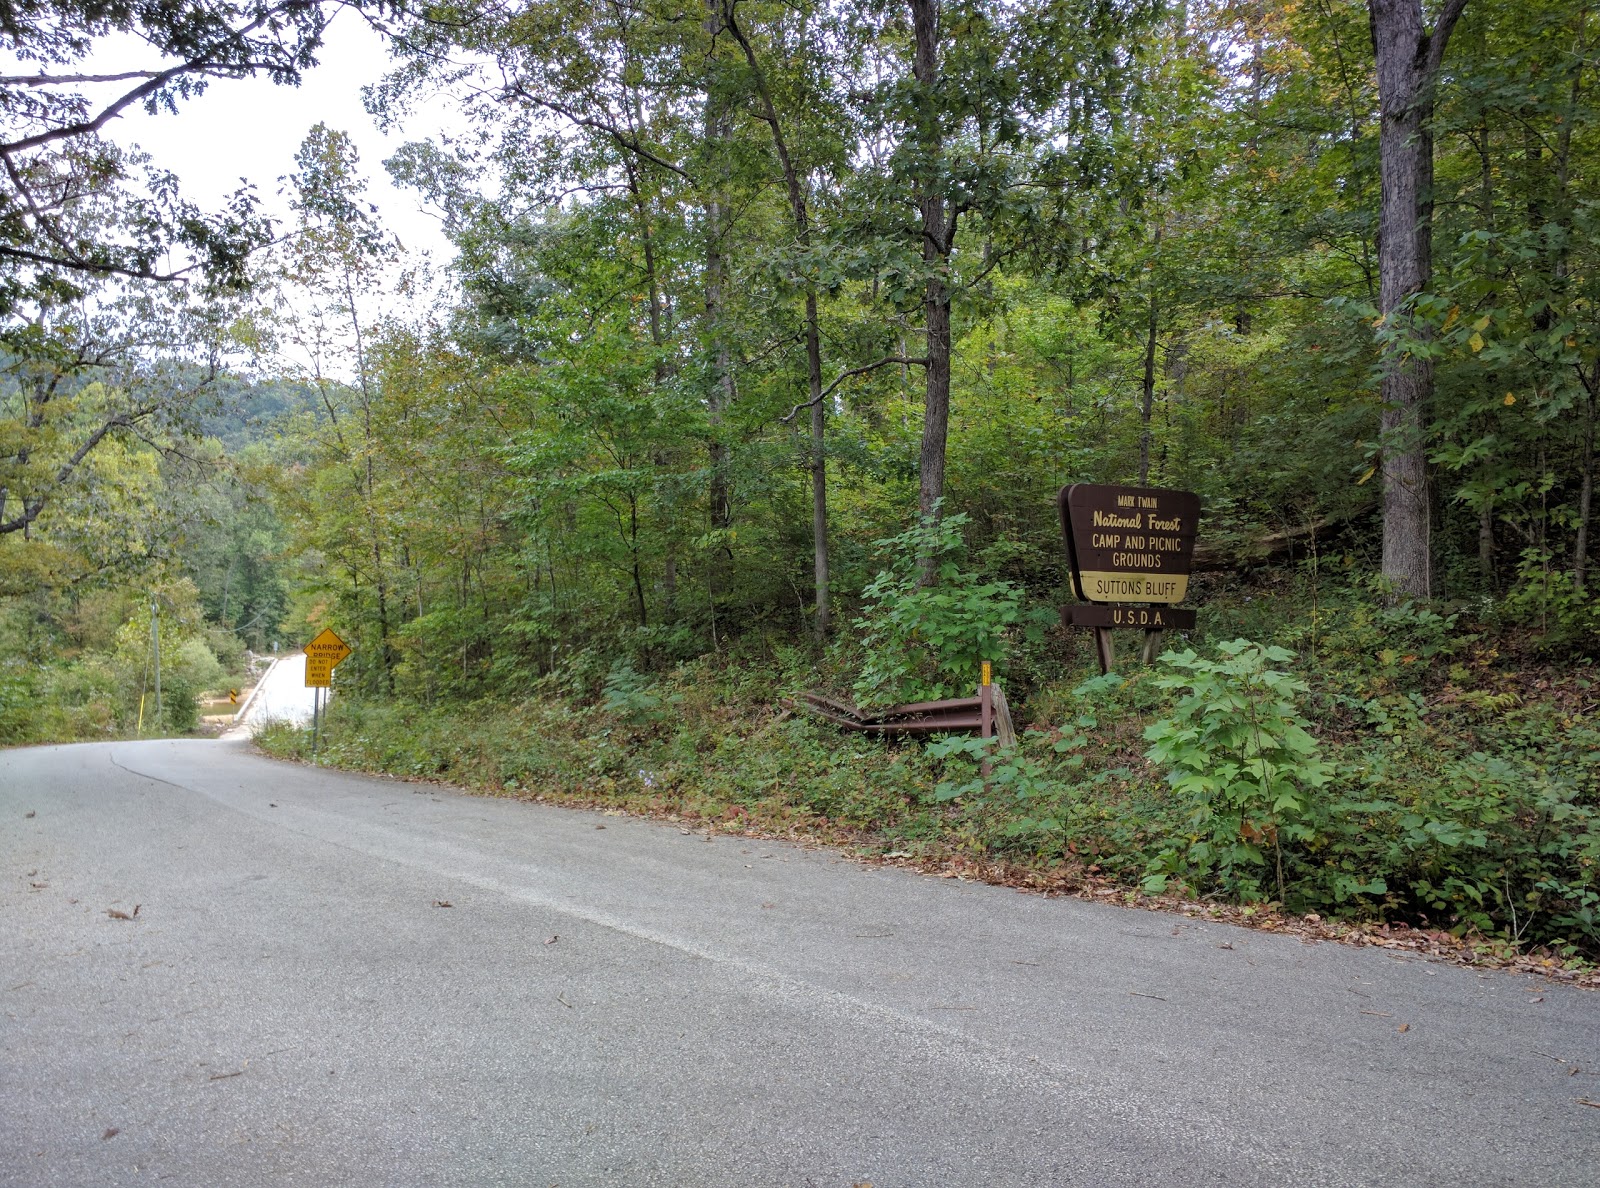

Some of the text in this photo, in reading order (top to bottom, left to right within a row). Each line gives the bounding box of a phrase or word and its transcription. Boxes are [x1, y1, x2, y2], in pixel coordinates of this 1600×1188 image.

[1117, 495, 1158, 509] MARK TWAIN
[1093, 511, 1181, 531] National Forest
[1092, 533, 1181, 552] CAMP AND PICNIC
[1112, 552, 1161, 568] GROUNDS
[1096, 580, 1177, 596] SUTTONS BLUFF
